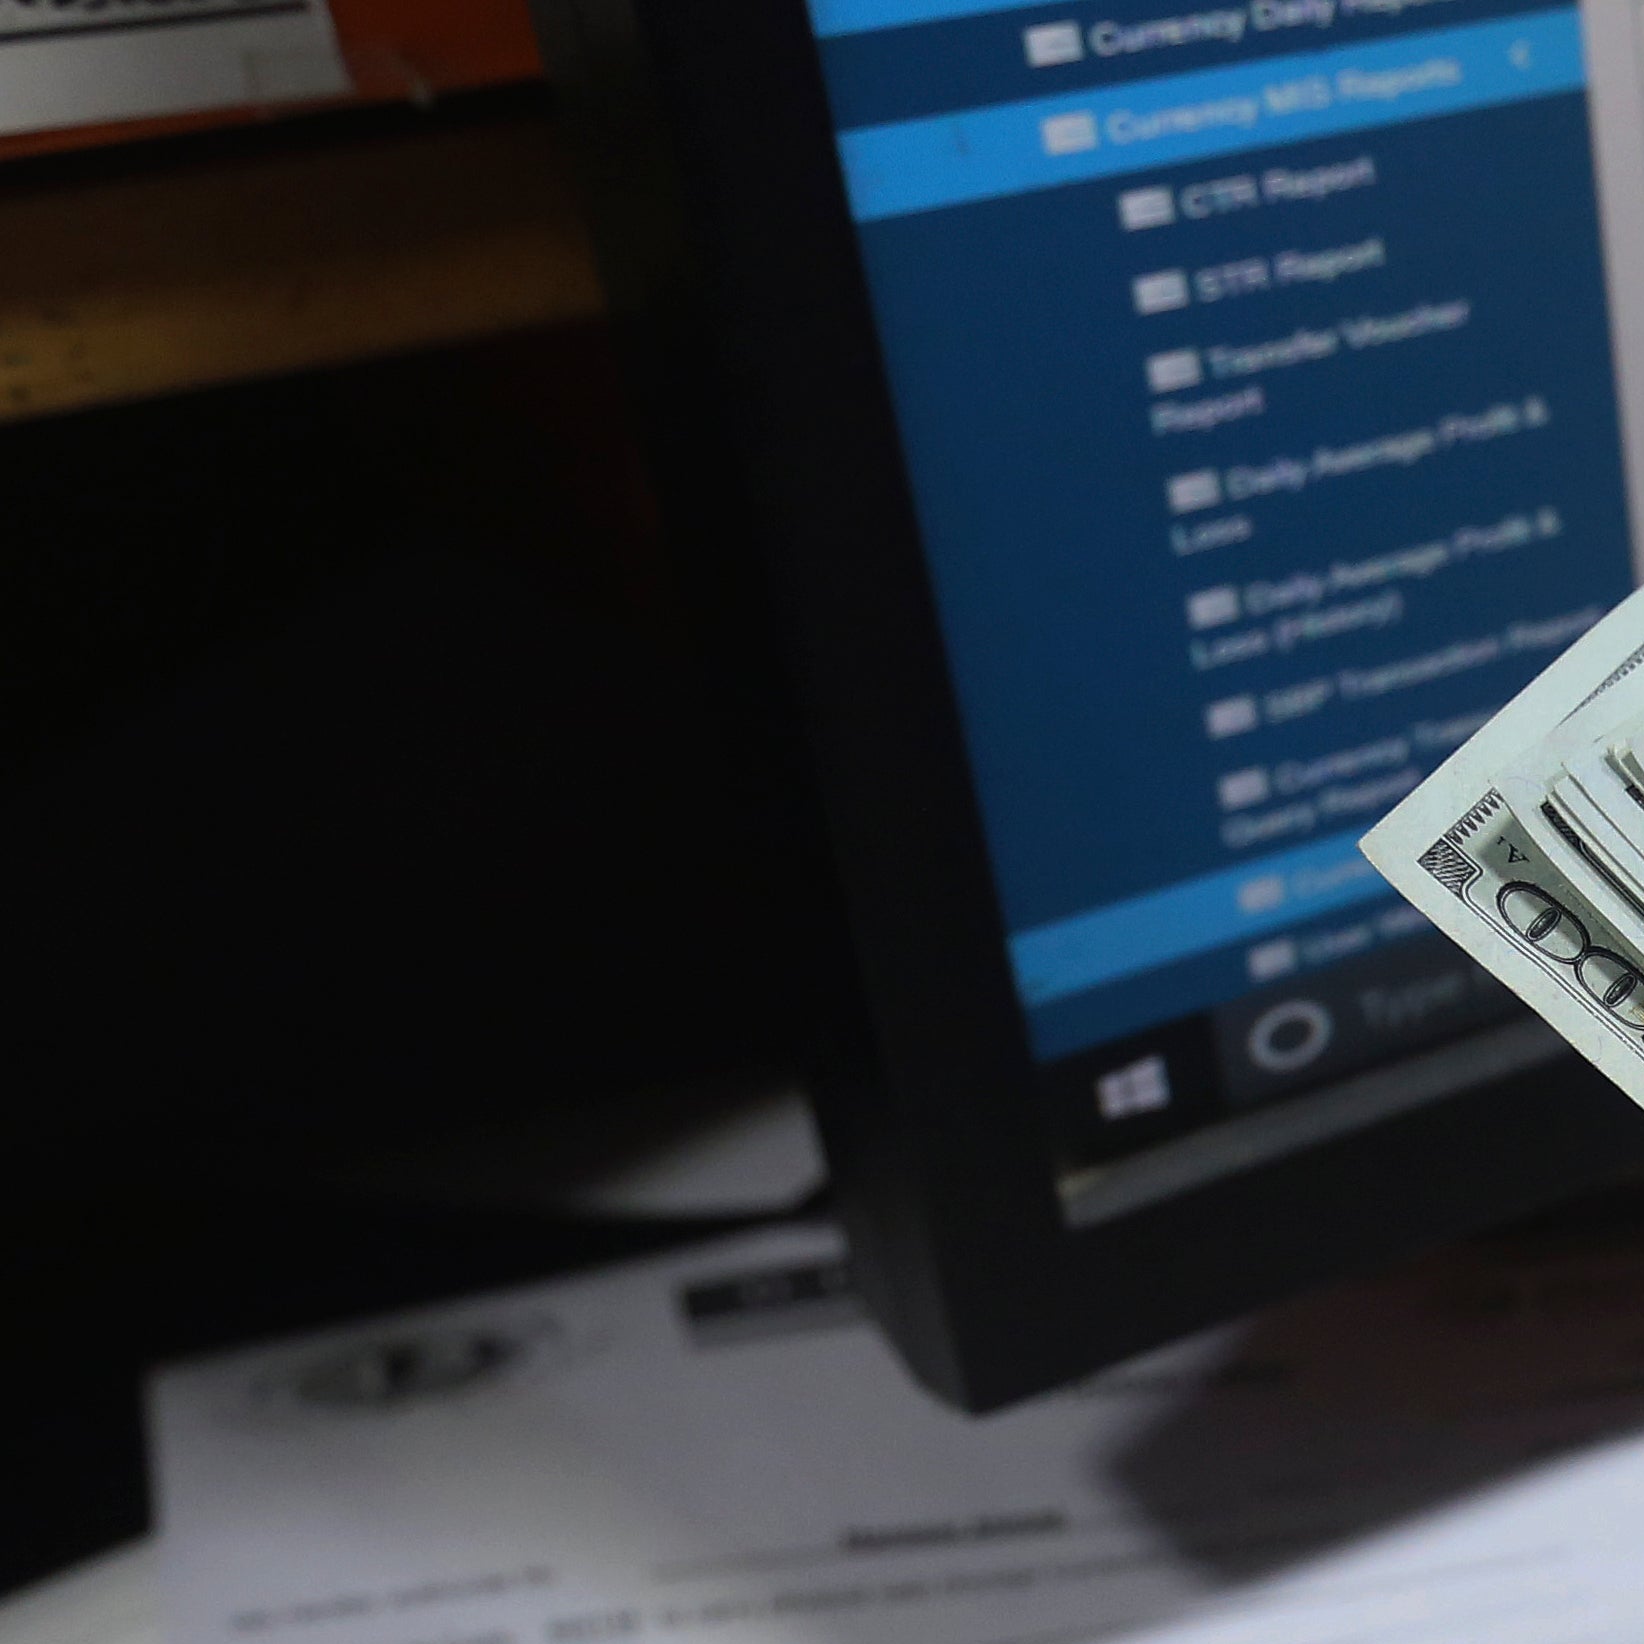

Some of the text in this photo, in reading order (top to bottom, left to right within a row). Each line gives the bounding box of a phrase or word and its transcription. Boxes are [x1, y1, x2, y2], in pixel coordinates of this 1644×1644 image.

[1105, 97, 1258, 145] Currency
[1260, 154, 1377, 201] Report
[1272, 237, 1387, 282] Report
[1205, 301, 1471, 379] Transfer Voucher
[1149, 385, 1265, 435] Report
